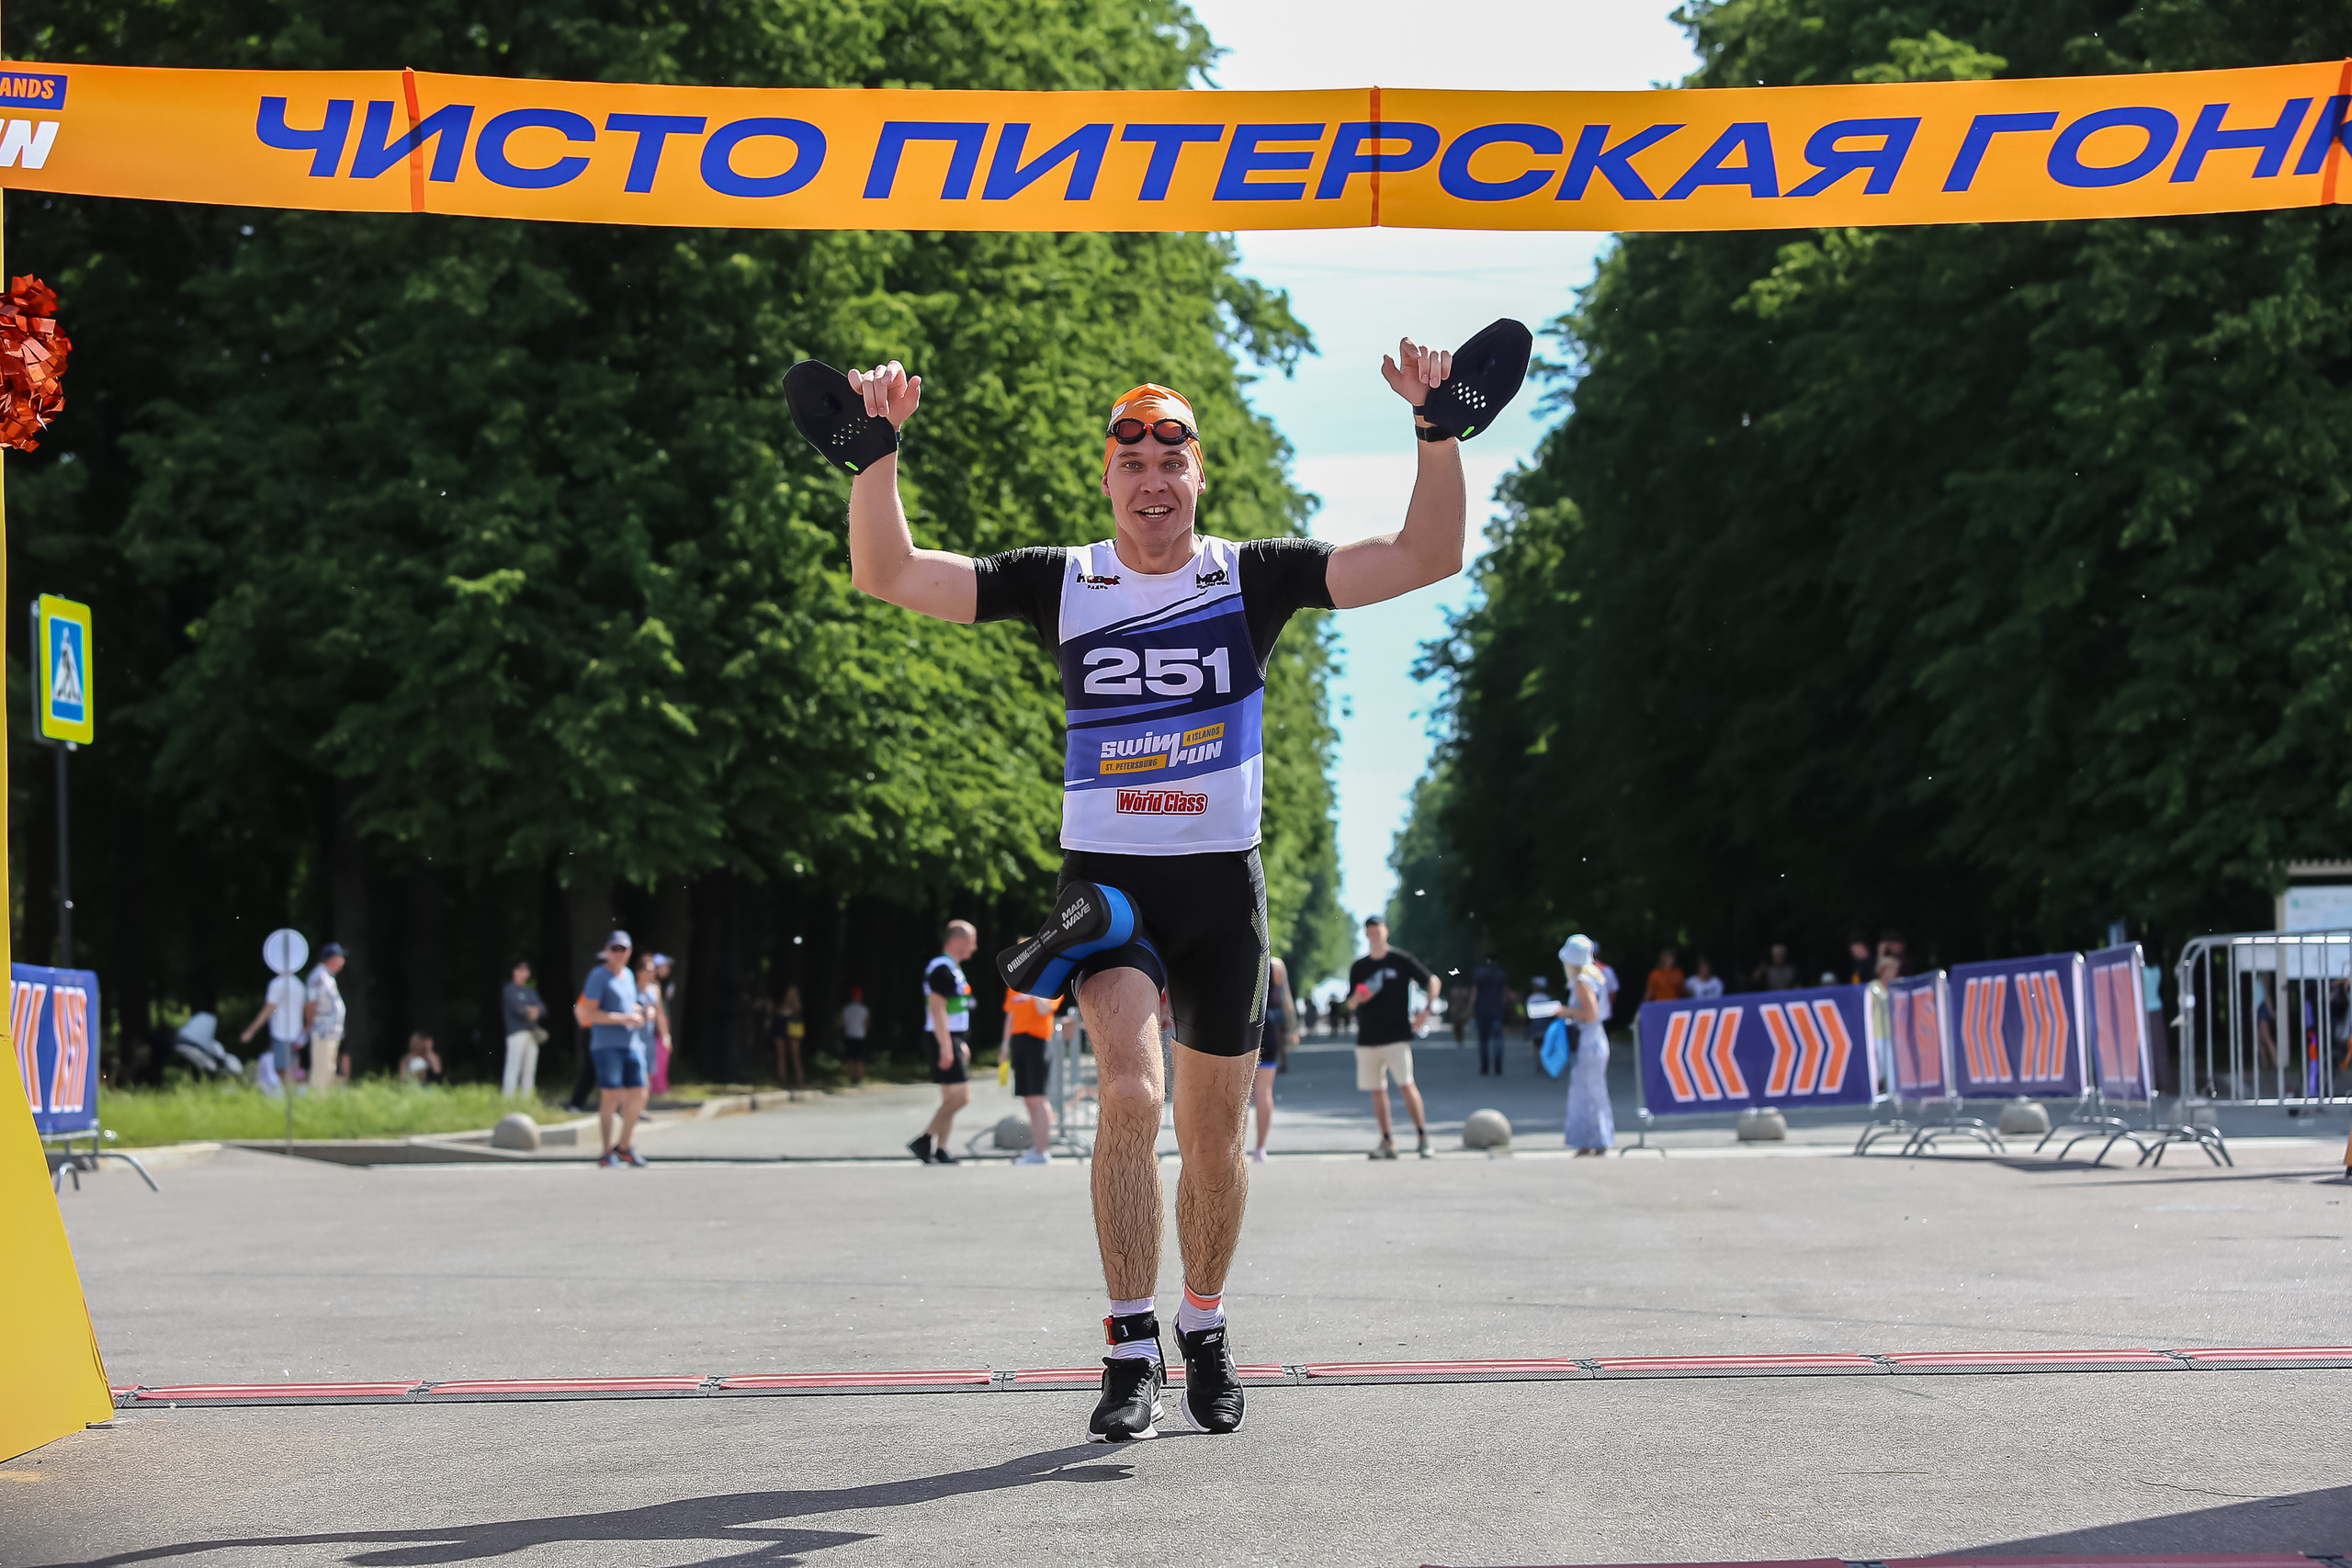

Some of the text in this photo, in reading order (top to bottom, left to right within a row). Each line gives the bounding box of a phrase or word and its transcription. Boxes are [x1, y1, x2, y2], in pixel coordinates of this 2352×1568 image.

[255, 96, 827, 198] ЧИСТО
[863, 117, 1922, 202] ПИТЕРСКАЯ
[1082, 647, 1230, 695] 251
[1192, 727, 1220, 741] ISLANDS
[1115, 759, 1158, 770] PETERSBURG
[1120, 793, 1205, 812] World Class
[1061, 897, 1085, 921] MAD
[1062, 902, 1091, 930] WAVE
